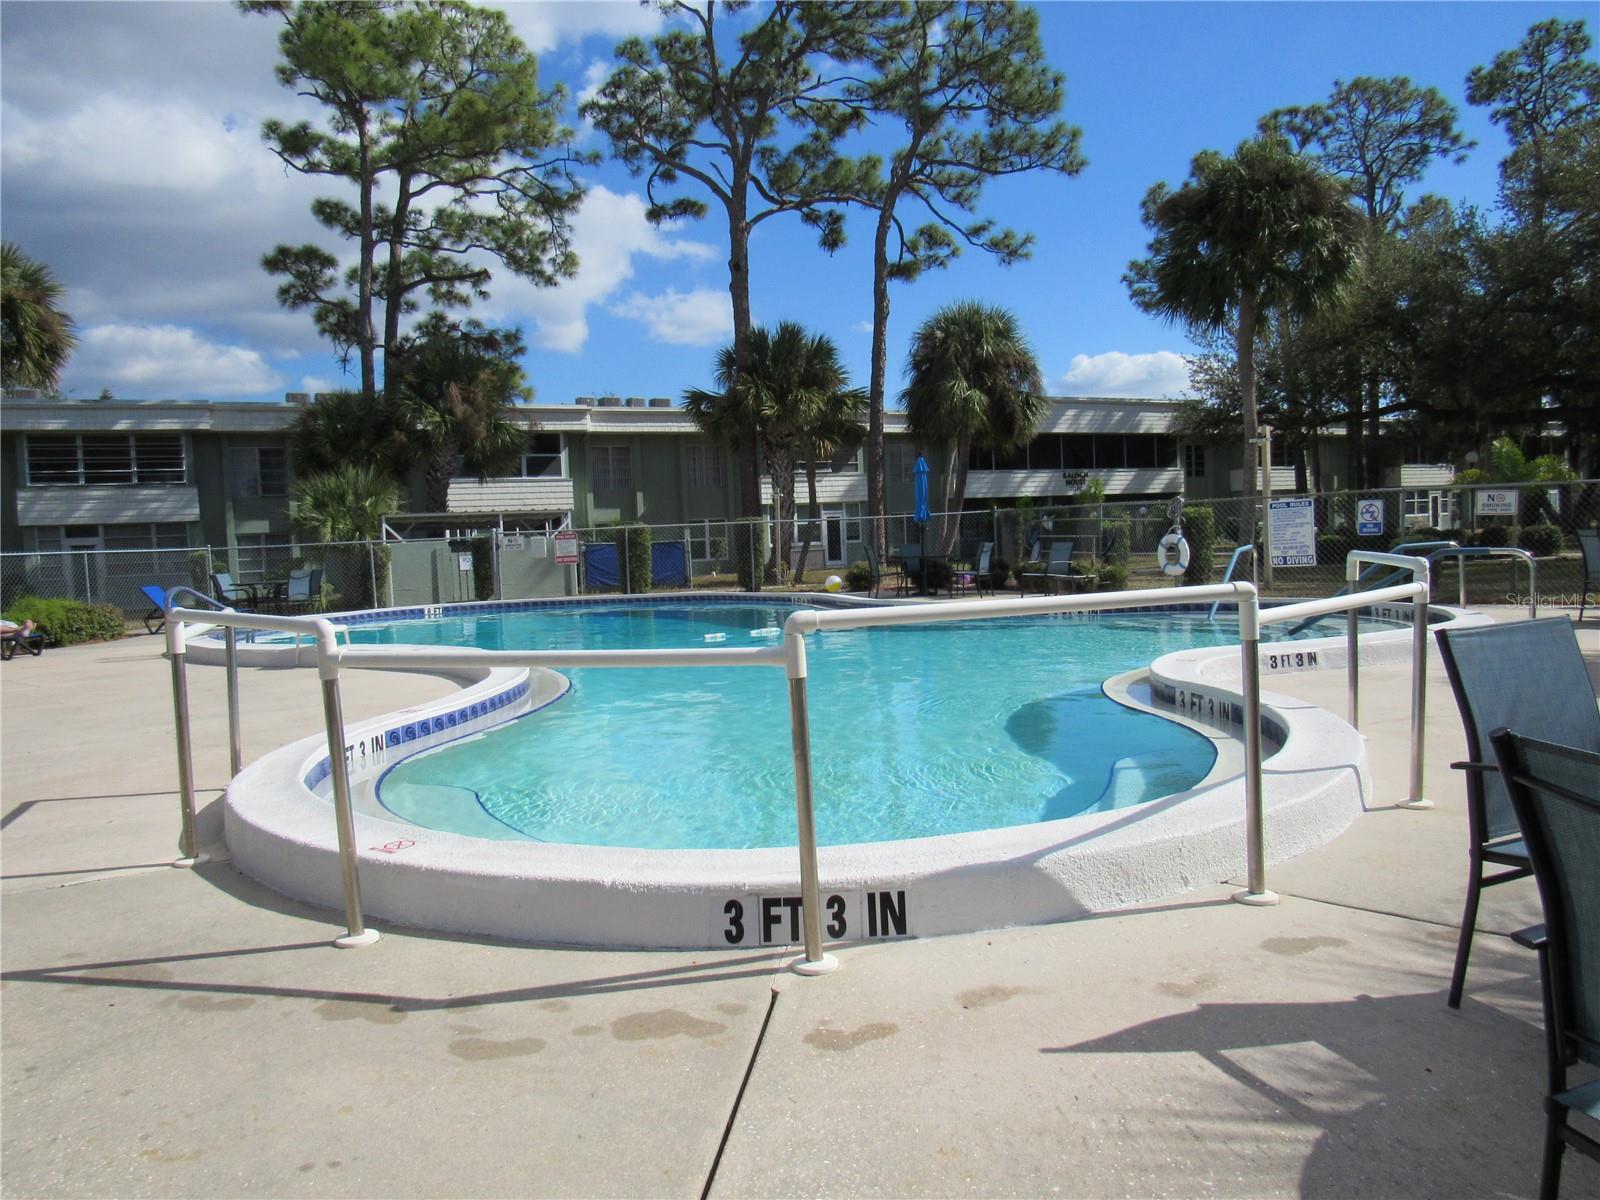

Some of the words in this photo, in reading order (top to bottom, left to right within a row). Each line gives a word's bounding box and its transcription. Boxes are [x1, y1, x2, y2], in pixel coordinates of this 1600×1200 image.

[1272, 556, 1284, 565] NO
[1286, 555, 1314, 565] DIVING
[1382, 608, 1392, 619] FT
[1270, 655, 1278, 669] 3
[1295, 652, 1304, 667] 3
[1306, 651, 1318, 666] IN
[1179, 690, 1186, 709] 3
[1190, 692, 1204, 713] FT
[1208, 698, 1214, 716] 3
[1219, 700, 1230, 721] IN
[359, 740, 366, 758] 3
[371, 734, 384, 753] IN
[723, 899, 745, 944] 3
[762, 896, 804, 943] FT
[826, 894, 847, 939] 3
[867, 890, 907, 937] IN
